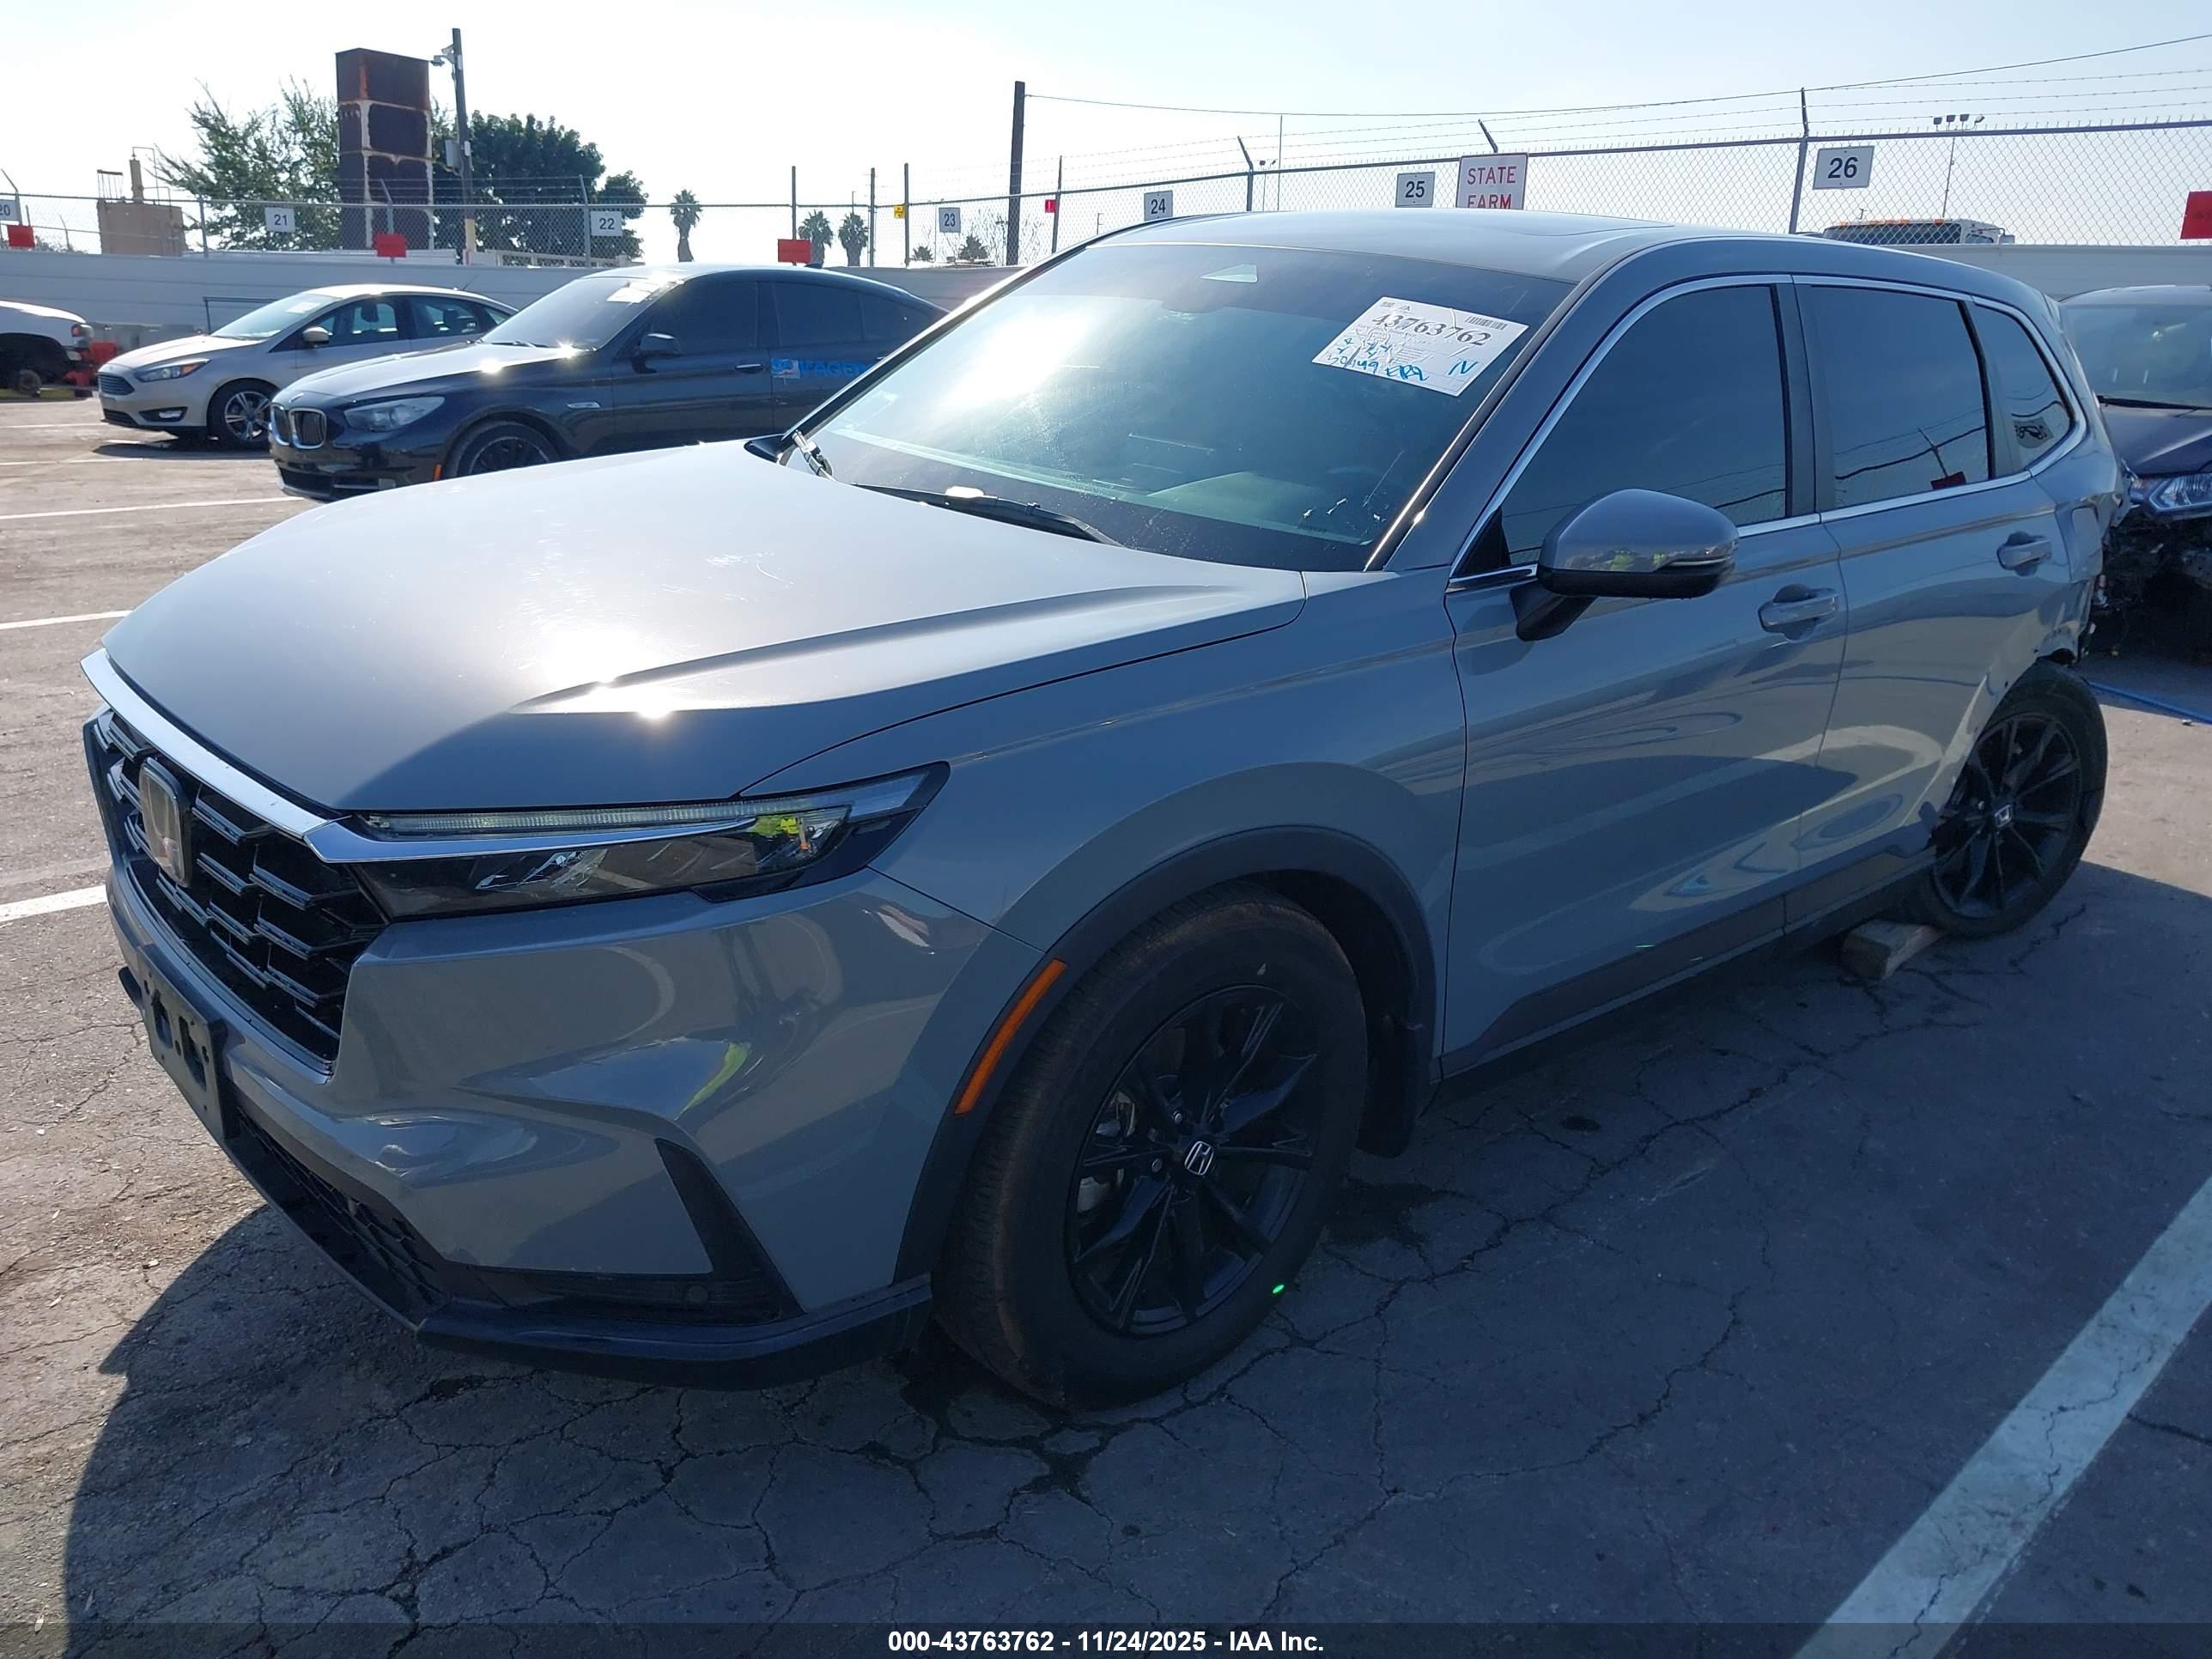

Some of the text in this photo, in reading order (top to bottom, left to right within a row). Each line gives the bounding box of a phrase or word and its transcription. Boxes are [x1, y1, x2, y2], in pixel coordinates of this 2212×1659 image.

[1467, 166, 1517, 185] STATE
[1826, 156, 1858, 179] 26
[1405, 180, 1425, 198] 25
[1151, 198, 1166, 215] 24
[1467, 194, 1512, 210] FARM
[274, 214, 288, 226] 21
[599, 218, 616, 230] 22
[944, 213, 956, 228] 23
[1371, 313, 1492, 346] 43763762
